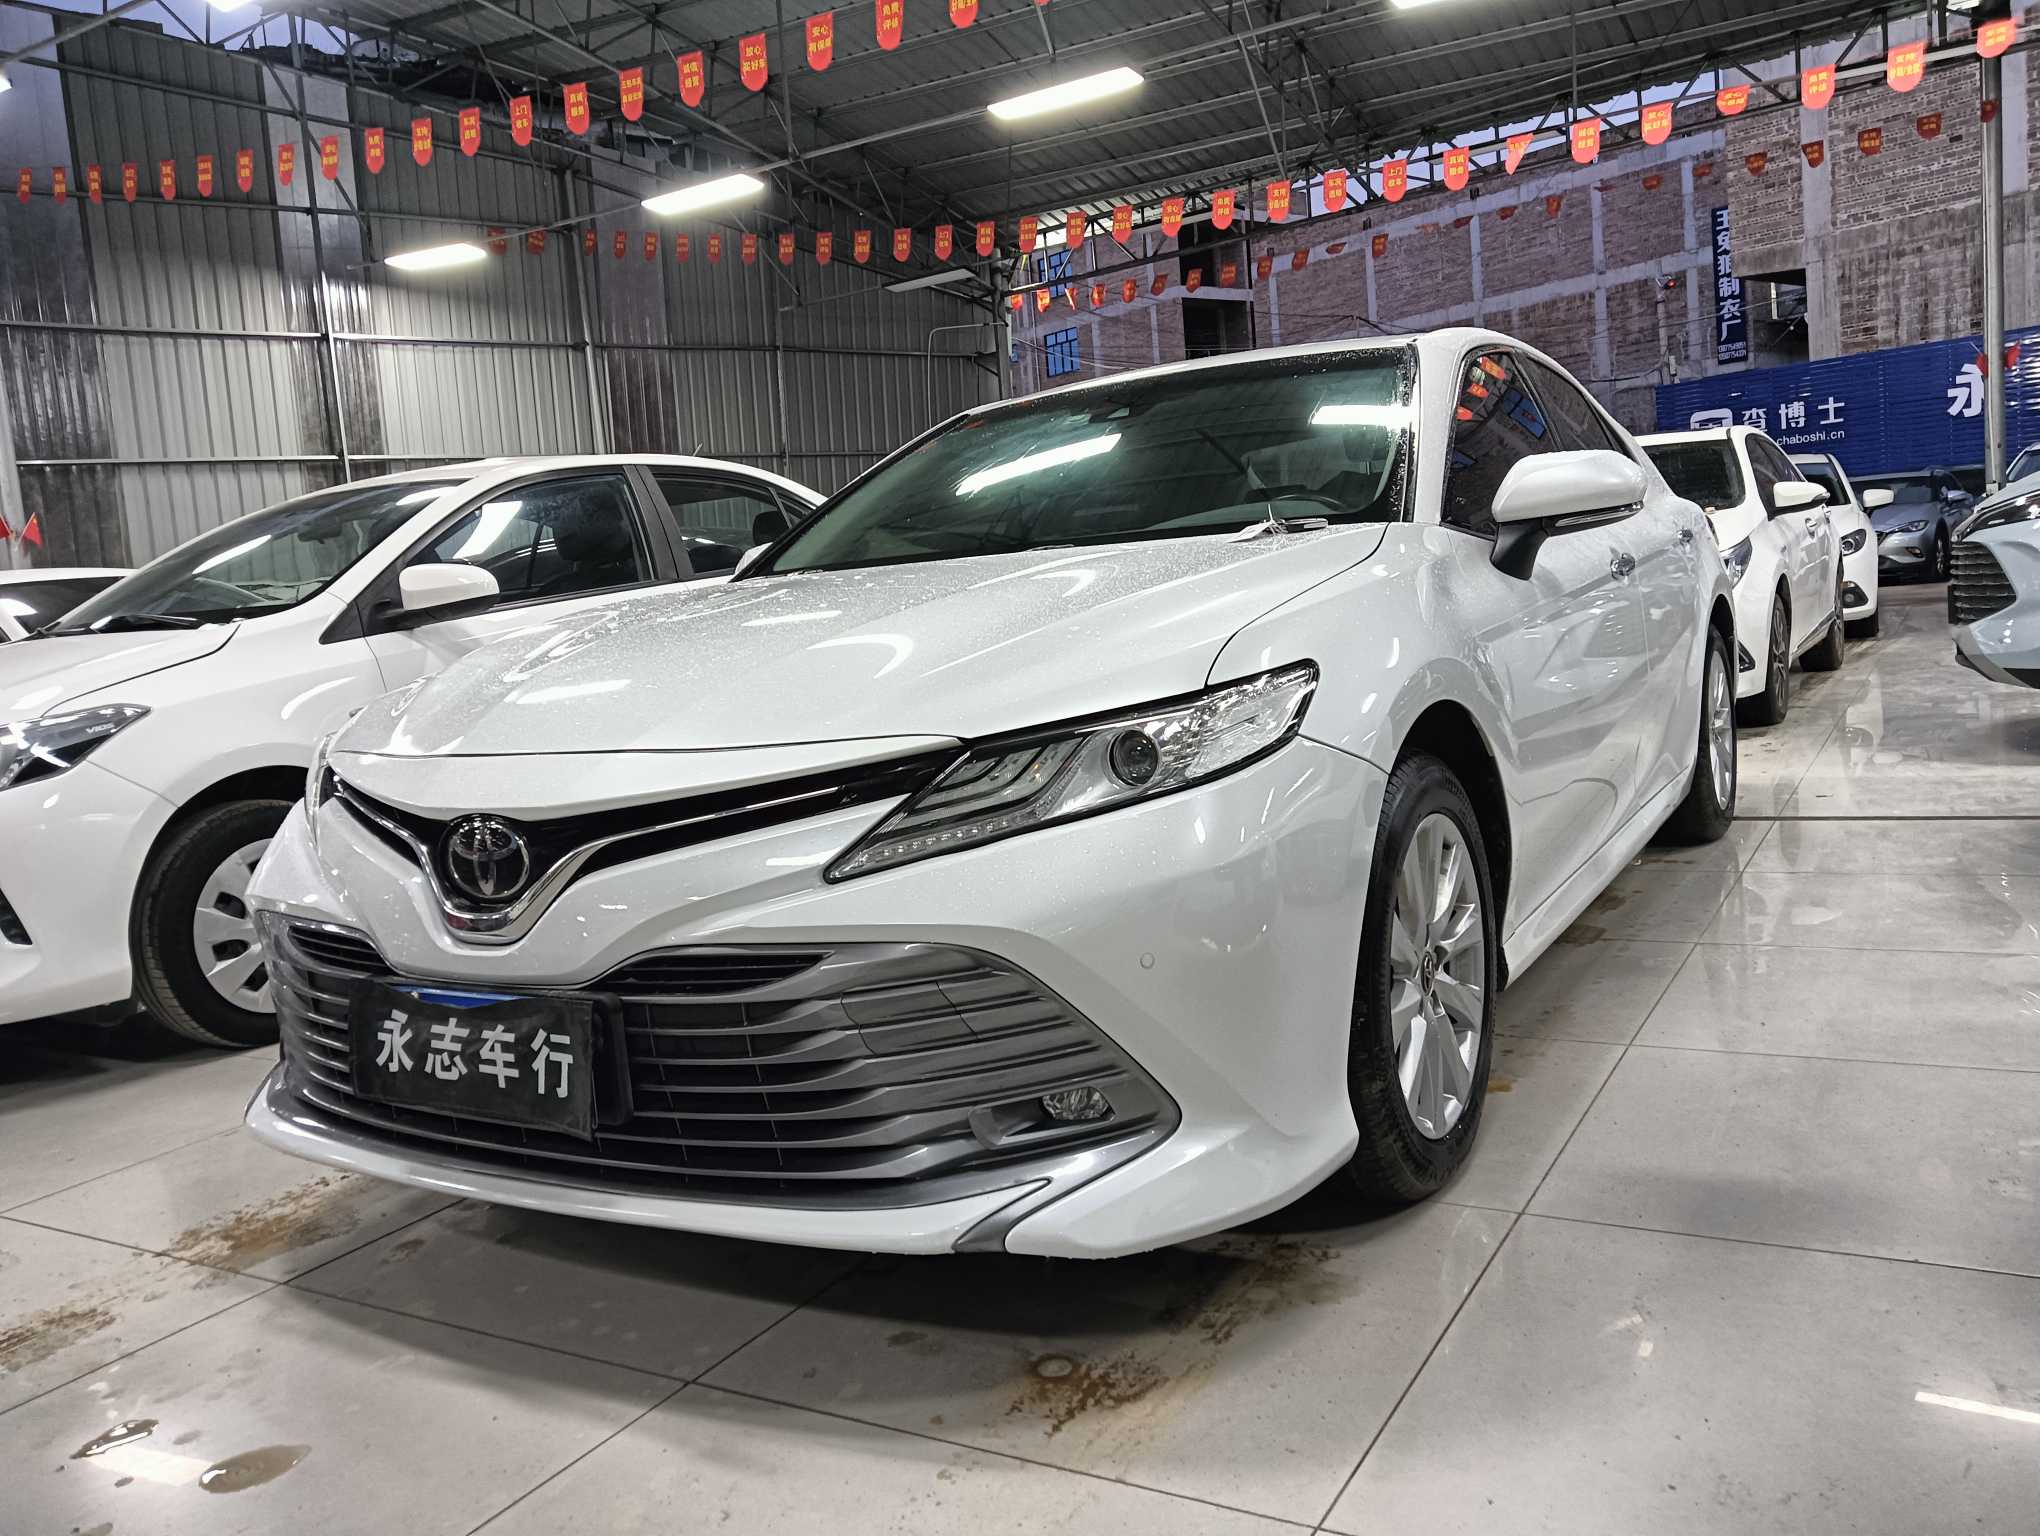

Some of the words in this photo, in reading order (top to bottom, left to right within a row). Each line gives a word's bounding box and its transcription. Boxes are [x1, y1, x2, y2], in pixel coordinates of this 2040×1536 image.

[812, 25, 828, 37] 安心
[746, 46, 761, 57] 放心
[809, 38, 832, 53] 有保障
[743, 59, 767, 71] 买好车
[1389, 167, 1402, 176] 上门
[1389, 179, 1402, 187] 收车
[1742, 397, 1845, 432] 查博士
[1776, 430, 1845, 446] chaboshi.cn
[376, 1009, 573, 1098] 永志车行
